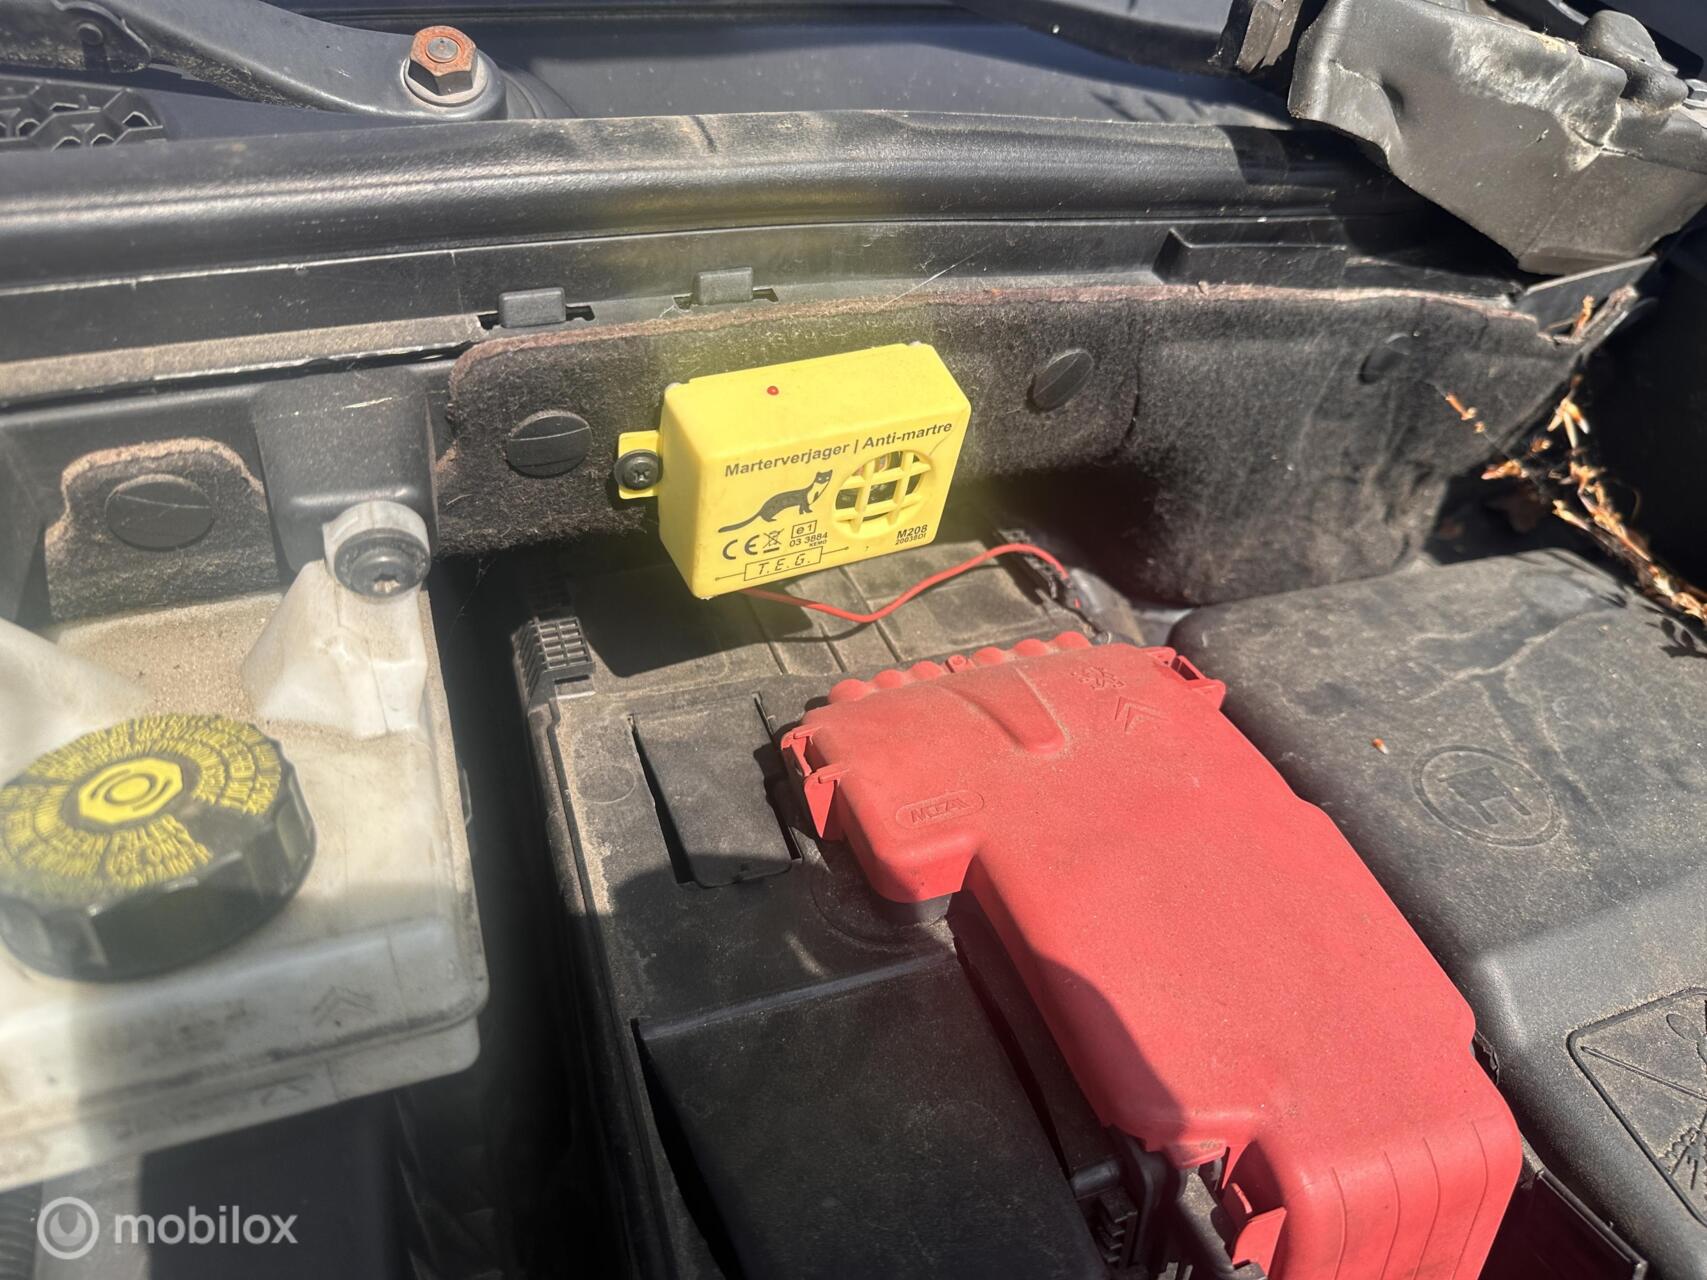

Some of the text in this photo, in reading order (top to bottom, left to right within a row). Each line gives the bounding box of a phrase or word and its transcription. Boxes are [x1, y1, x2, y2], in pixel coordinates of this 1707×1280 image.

[724, 442, 850, 477] Marterverjager
[862, 422, 953, 450] Anti-martre
[789, 531, 828, 547] 03 3884
[897, 524, 928, 539] M208
